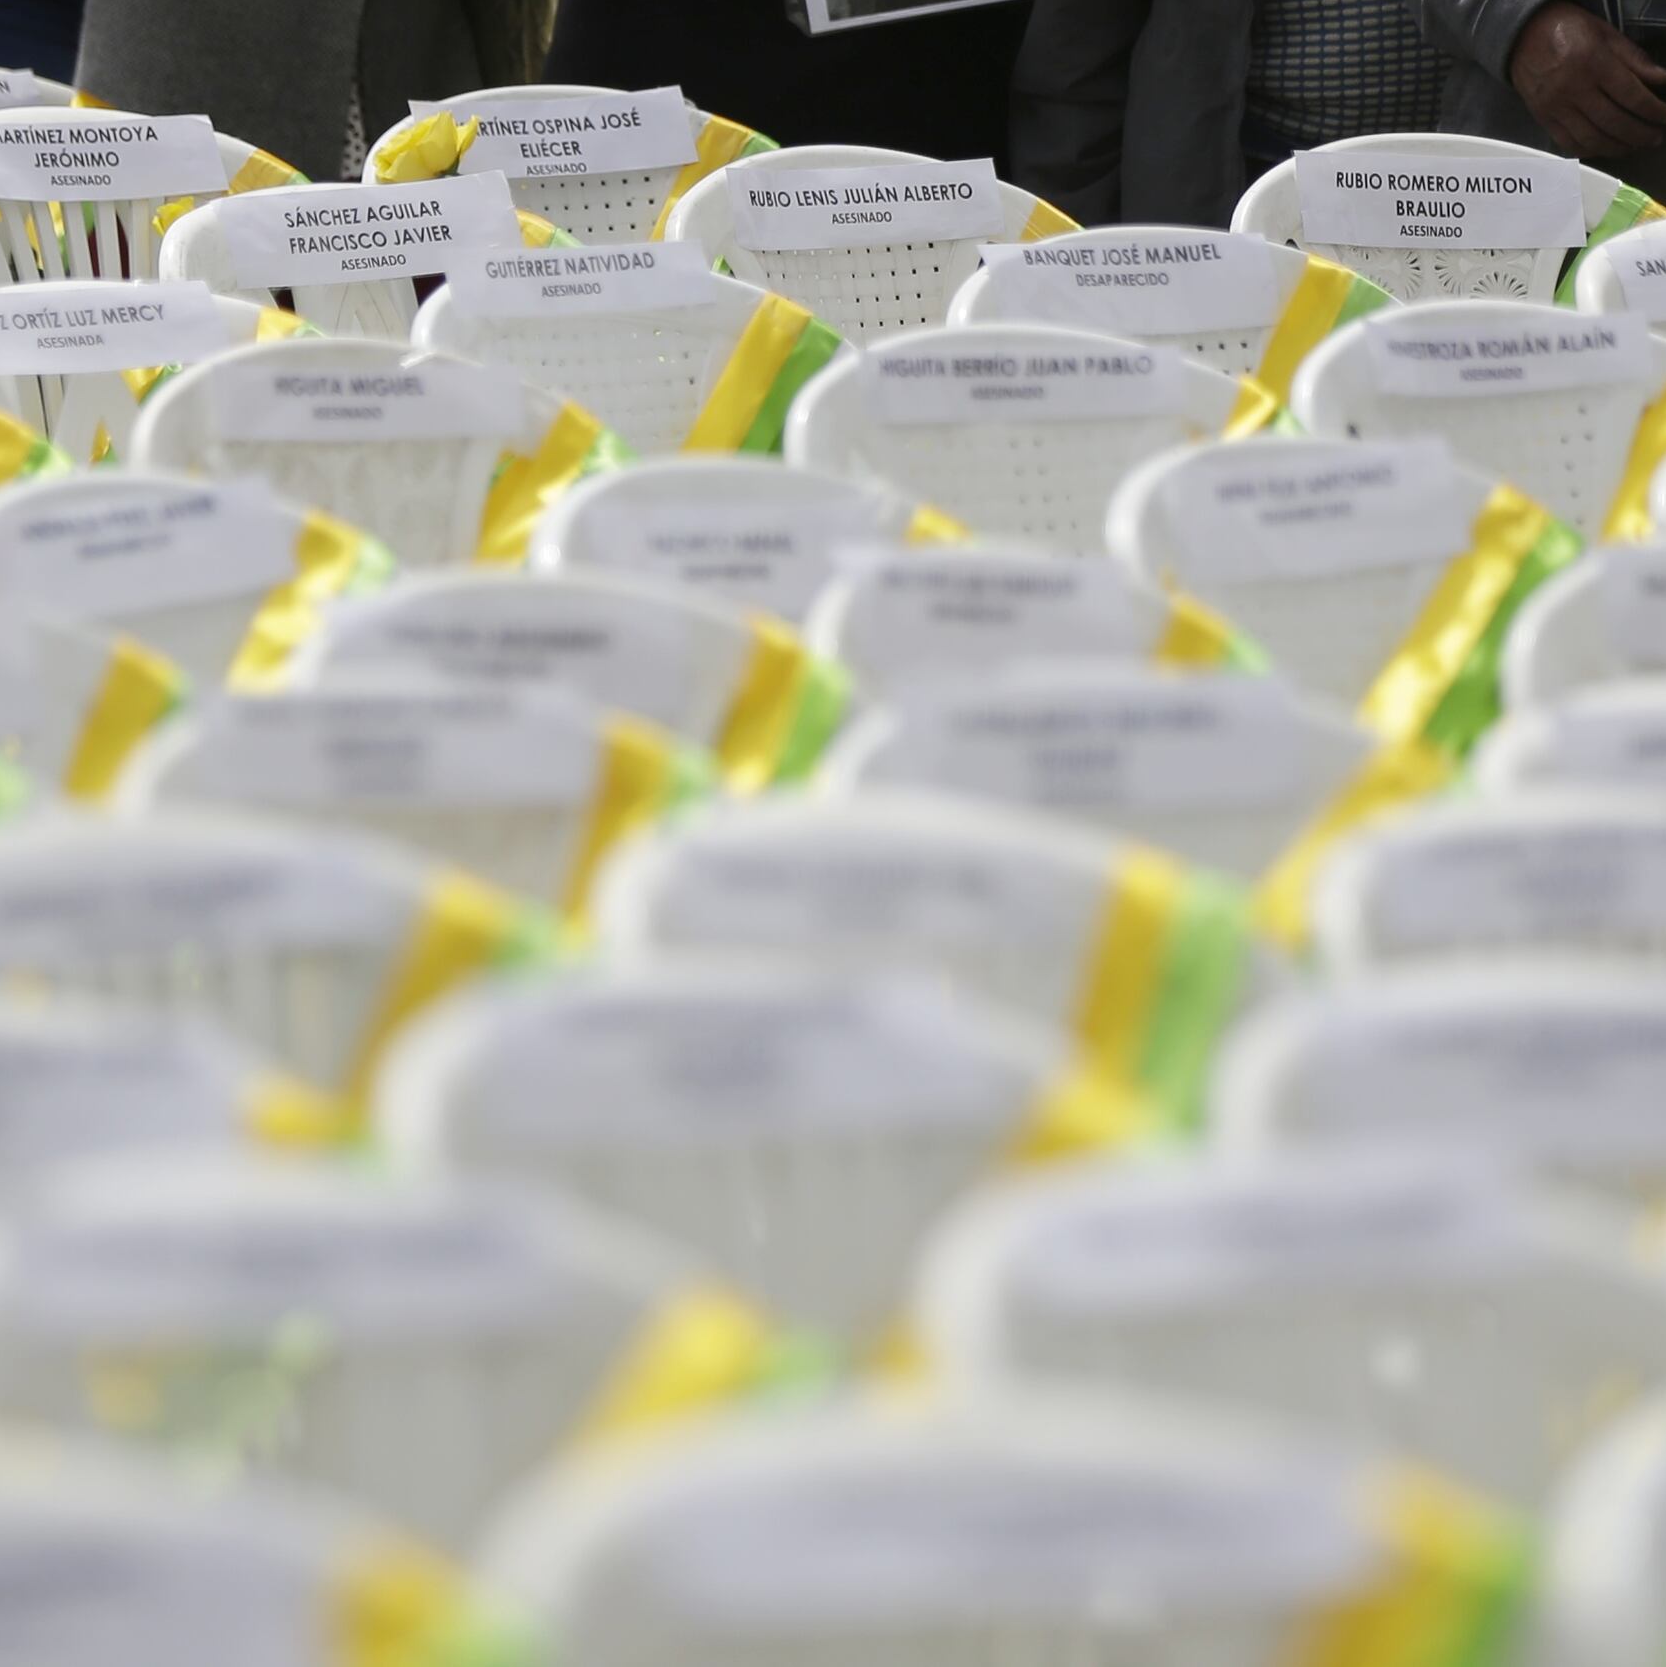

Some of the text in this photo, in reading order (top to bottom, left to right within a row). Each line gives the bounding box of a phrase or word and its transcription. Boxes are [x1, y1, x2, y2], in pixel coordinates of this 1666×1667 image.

[532, 117, 595, 135] OSPINA
[601, 106, 641, 130] JOSÉ
[69, 125, 159, 145] MONTOYA
[34, 147, 120, 169] JERÓNIMO
[520, 138, 582, 159] ELIÉCER
[50, 173, 112, 187] ASESINADO
[525, 162, 588, 177] ASESINADO
[1335, 170, 1533, 196] RUBIO ROMERO MILTON
[748, 182, 974, 208] RUBIO LENIS JULIÁN ALBERTO
[284, 200, 442, 230] SÁNCHEZ AGUILAR
[830, 210, 893, 225] ASESINADO
[1395, 199, 1466, 219] BRAULIO
[288, 224, 453, 255] FRANCISCO JAVIER
[1399, 223, 1464, 238] ASESINADO
[340, 253, 407, 272] ASESINADO
[485, 251, 656, 279] GUTIÉRREZ NATIVIDAD
[1024, 243, 1222, 268] BANQUET JOSÉ MANUEL
[540, 281, 602, 298] ASESINADO
[1075, 272, 1170, 287] DESAPARECIDO
[11, 308, 60, 331] ORTÍZ
[64, 310, 95, 328] LUZ
[99, 304, 165, 326] MERCY
[1477, 333, 1550, 359] ROMÁN
[1557, 327, 1617, 353] ALAÍN
[1023, 357, 1078, 377] JUAN
